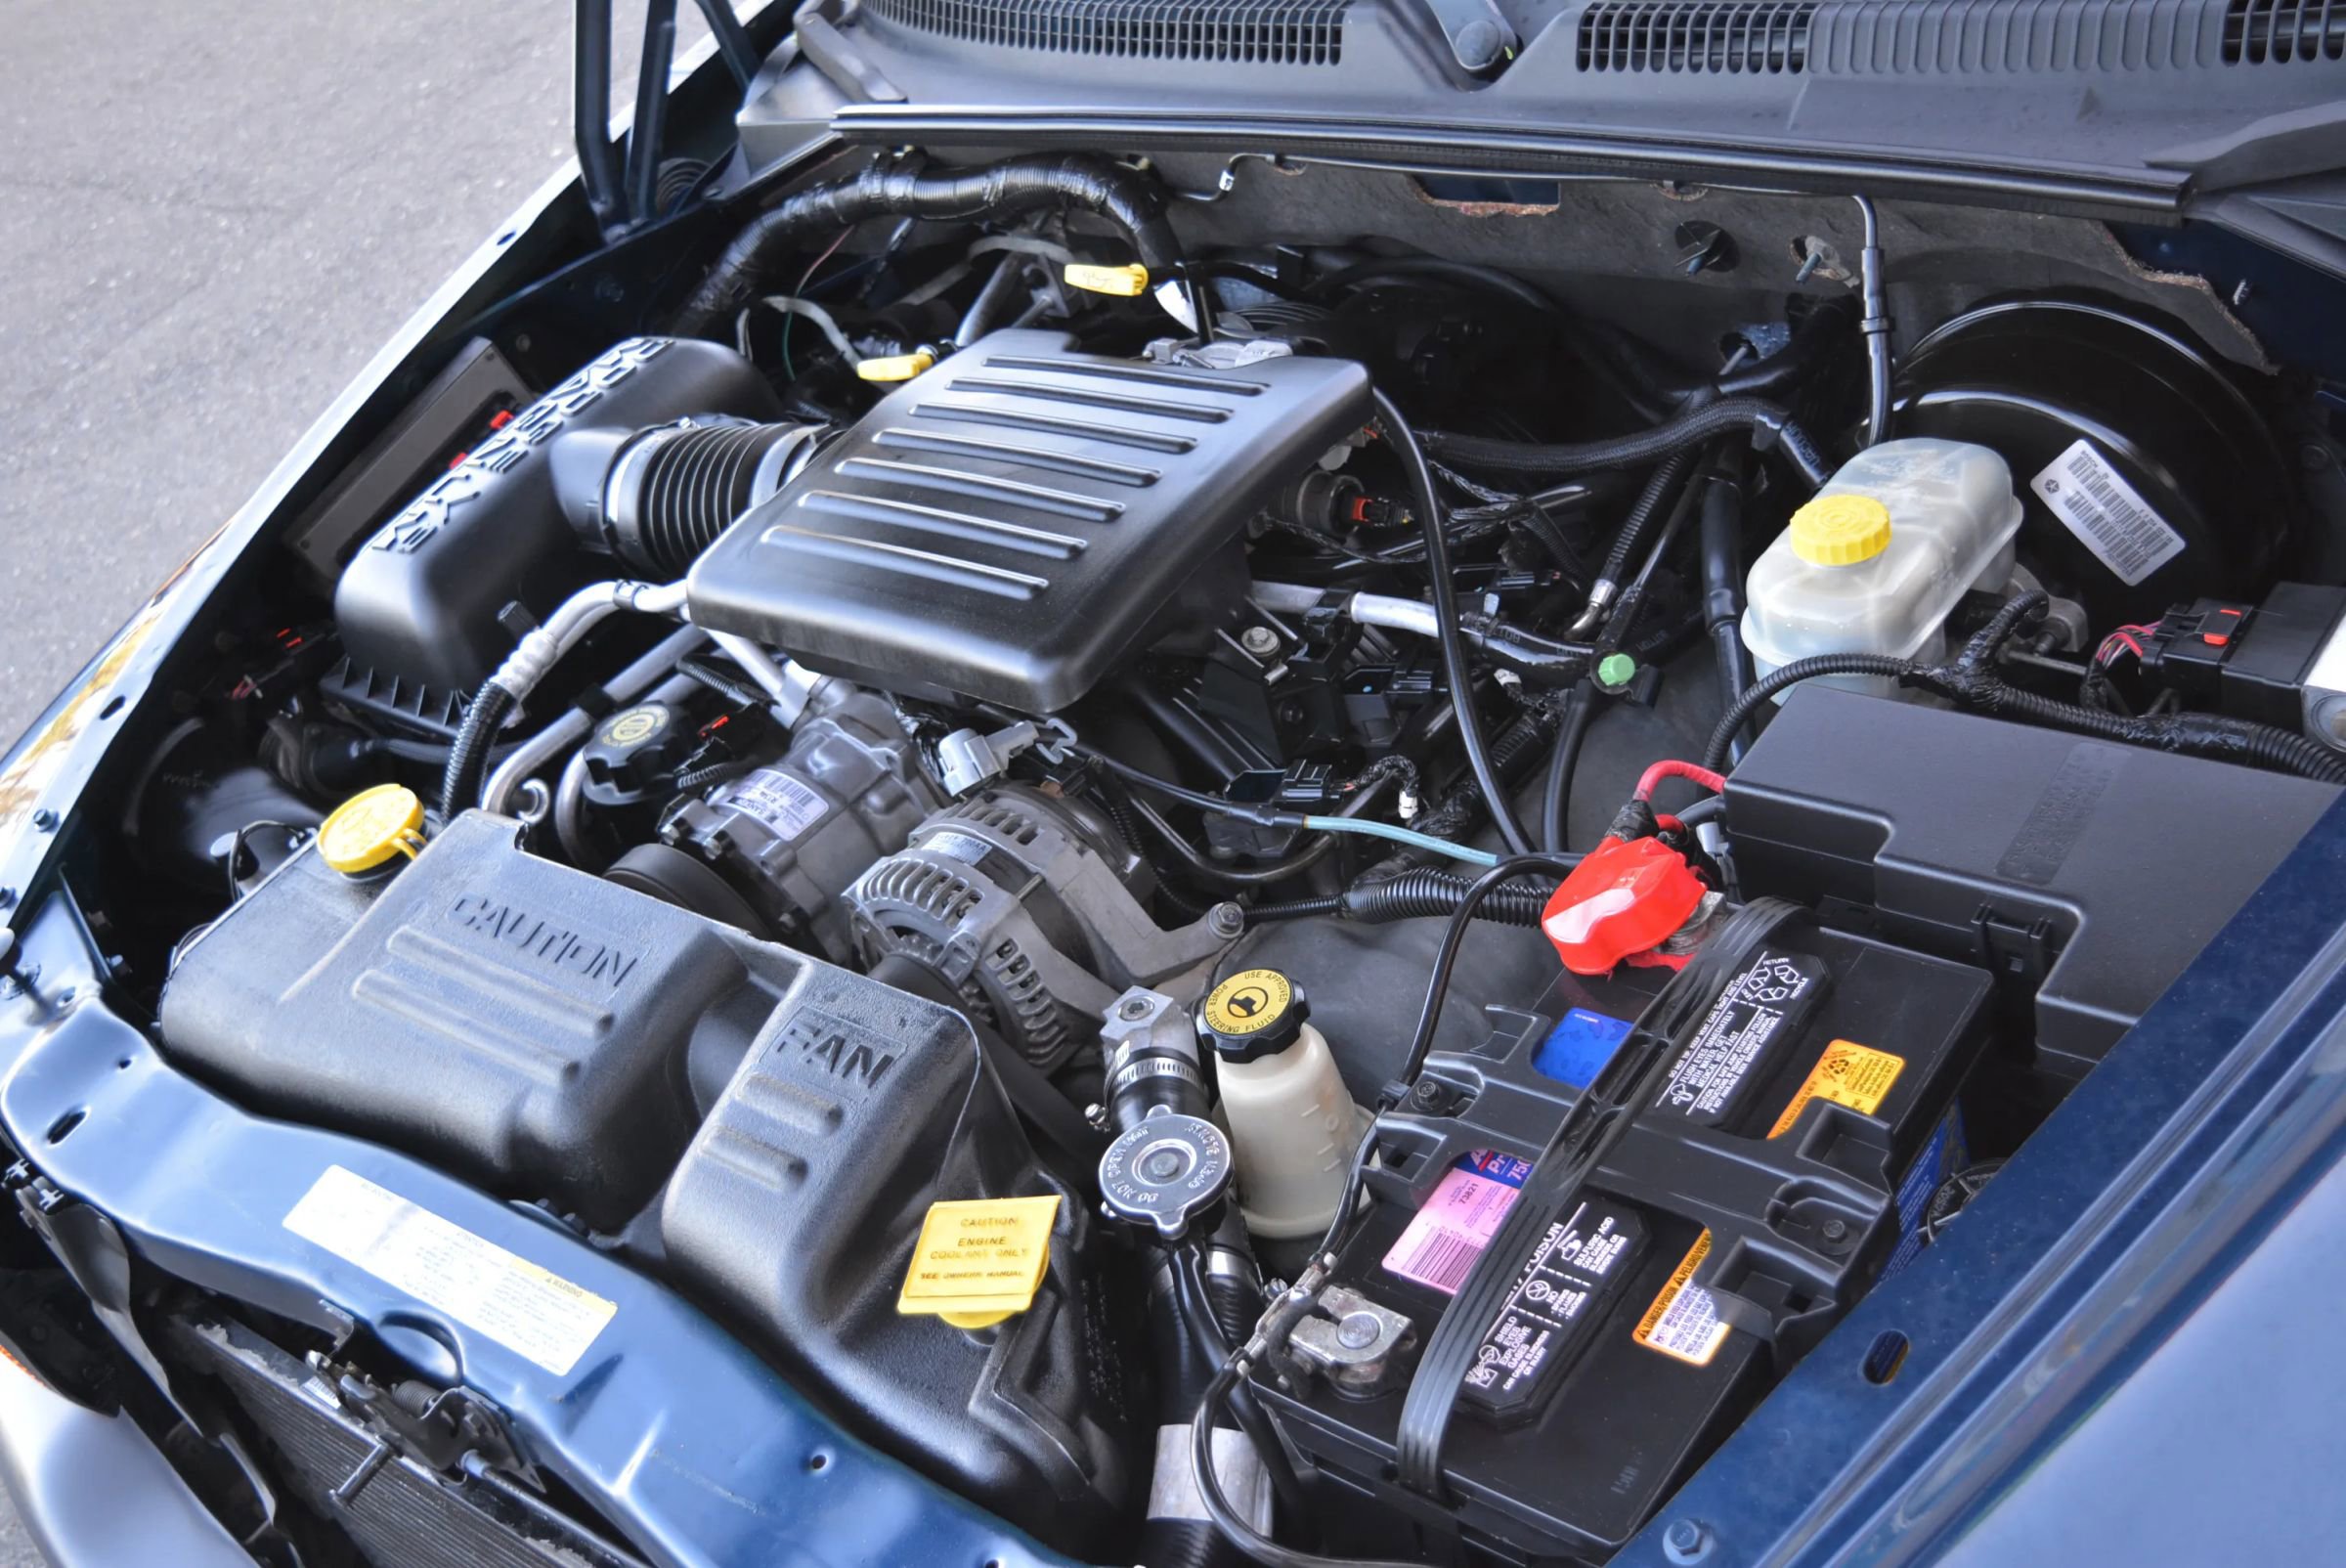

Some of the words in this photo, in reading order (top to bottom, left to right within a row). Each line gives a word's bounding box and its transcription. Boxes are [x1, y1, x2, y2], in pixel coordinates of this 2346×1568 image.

[489, 339, 675, 474] DODGE
[371, 337, 653, 551] MAGNUM
[398, 491, 481, 554] V8
[454, 897, 638, 987] CAUTION
[1208, 984, 1229, 1007] POWER
[1244, 970, 1263, 980] USE
[1265, 973, 1288, 1003] APPROVED
[1206, 1010, 1240, 1033] STEERING
[1245, 1014, 1276, 1032] FLUID
[776, 1023, 895, 1090] FAN
[1674, 1060, 1684, 1069] NOT
[1690, 1036, 1700, 1049] KEEP
[1698, 1024, 1710, 1035] VENT
[1679, 1064, 1697, 1082] FLUSH
[1693, 1048, 1708, 1063] EYES
[1705, 1011, 1733, 1047] IMMEDIATELY
[1688, 1069, 1703, 1084] WITH
[1714, 1035, 1726, 1047] GET
[1696, 1064, 1717, 1087] MEDICAL
[1714, 1046, 1727, 1062] HELP
[1723, 1031, 1739, 1046] FAST
[1712, 1078, 1721, 1087] FOR
[1718, 1066, 1729, 1077] SAFE
[1727, 1053, 1738, 1066] JUMP
[1736, 1031, 1754, 1052] STARTING
[1751, 1013, 1766, 1030] FOLLOW
[1704, 1078, 1728, 1110] INSTRUCTIONS
[1729, 1055, 1746, 1071] VEHICLE
[1713, 1098, 1722, 1108] NOT
[1736, 1063, 1747, 1074] SEEK
[1745, 1044, 1760, 1062] SERVICE
[1111, 1179, 1137, 1199] NOT
[1138, 1192, 1159, 1203] DO
[1458, 1183, 1480, 1204] 73821
[960, 1217, 1020, 1228] CAUTION
[930, 1249, 989, 1260] COOLANT
[995, 1248, 1030, 1258] ONLY
[957, 1236, 1008, 1247] ENGINE
[1574, 1234, 1601, 1266] SULFURIC
[1598, 1217, 1614, 1234] ACID
[1582, 1256, 1593, 1268] CAN
[1590, 1238, 1606, 1256] CAUSE
[1546, 1291, 1558, 1303] NO
[1495, 1317, 1516, 1342] SHIELD
[1502, 1325, 1520, 1346] EYES
[1499, 1327, 1530, 1366] EXPLOSIVE
[1507, 1344, 1529, 1368] GASES
[1503, 1377, 1514, 1390] CAN
[1512, 1358, 1528, 1377] CAUSE
[1523, 1366, 1533, 1374] OR
